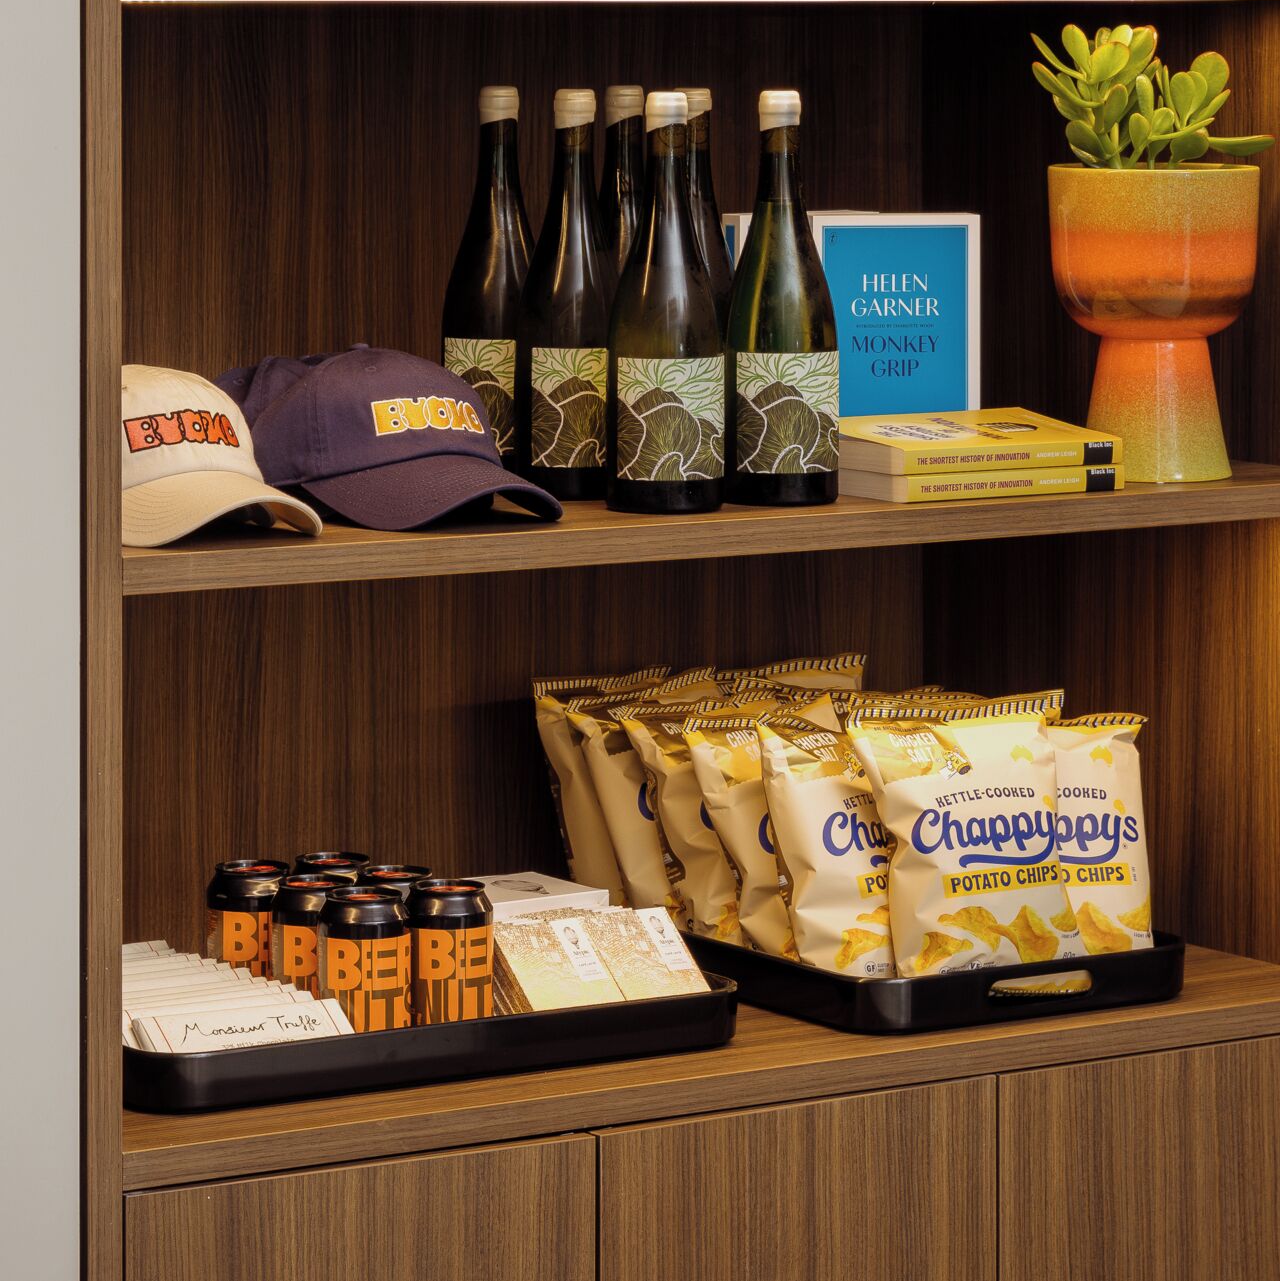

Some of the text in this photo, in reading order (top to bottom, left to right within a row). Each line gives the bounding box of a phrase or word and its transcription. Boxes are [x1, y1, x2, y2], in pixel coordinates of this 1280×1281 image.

[863, 273, 928, 292] HELEN
[851, 297, 939, 317] GARNER
[852, 335, 939, 353] MONKEY
[871, 359, 919, 377] GRIP
[917, 457, 927, 465] THE
[929, 457, 959, 465] SHORTEST
[960, 455, 985, 463] HISTORY
[986, 454, 993, 462] OF
[995, 452, 1030, 461] INNOVATION
[921, 485, 931, 493] THE
[933, 484, 962, 492] SHORTEST
[963, 482, 988, 491] HISTORY
[990, 481, 996, 489] OF
[998, 479, 1033, 489] INNOVATION
[793, 732, 838, 750] CHICKEN
[888, 732, 939, 747] CHICKEN
[813, 747, 838, 762] SALT
[907, 747, 935, 762] SALT
[935, 787, 1035, 808] KETTLE-COOKED
[951, 864, 1058, 894] POTATO CHIPS
[1077, 866, 1124, 882] CHIPS
[181, 1015, 321, 1046] Monsieur Truffe
